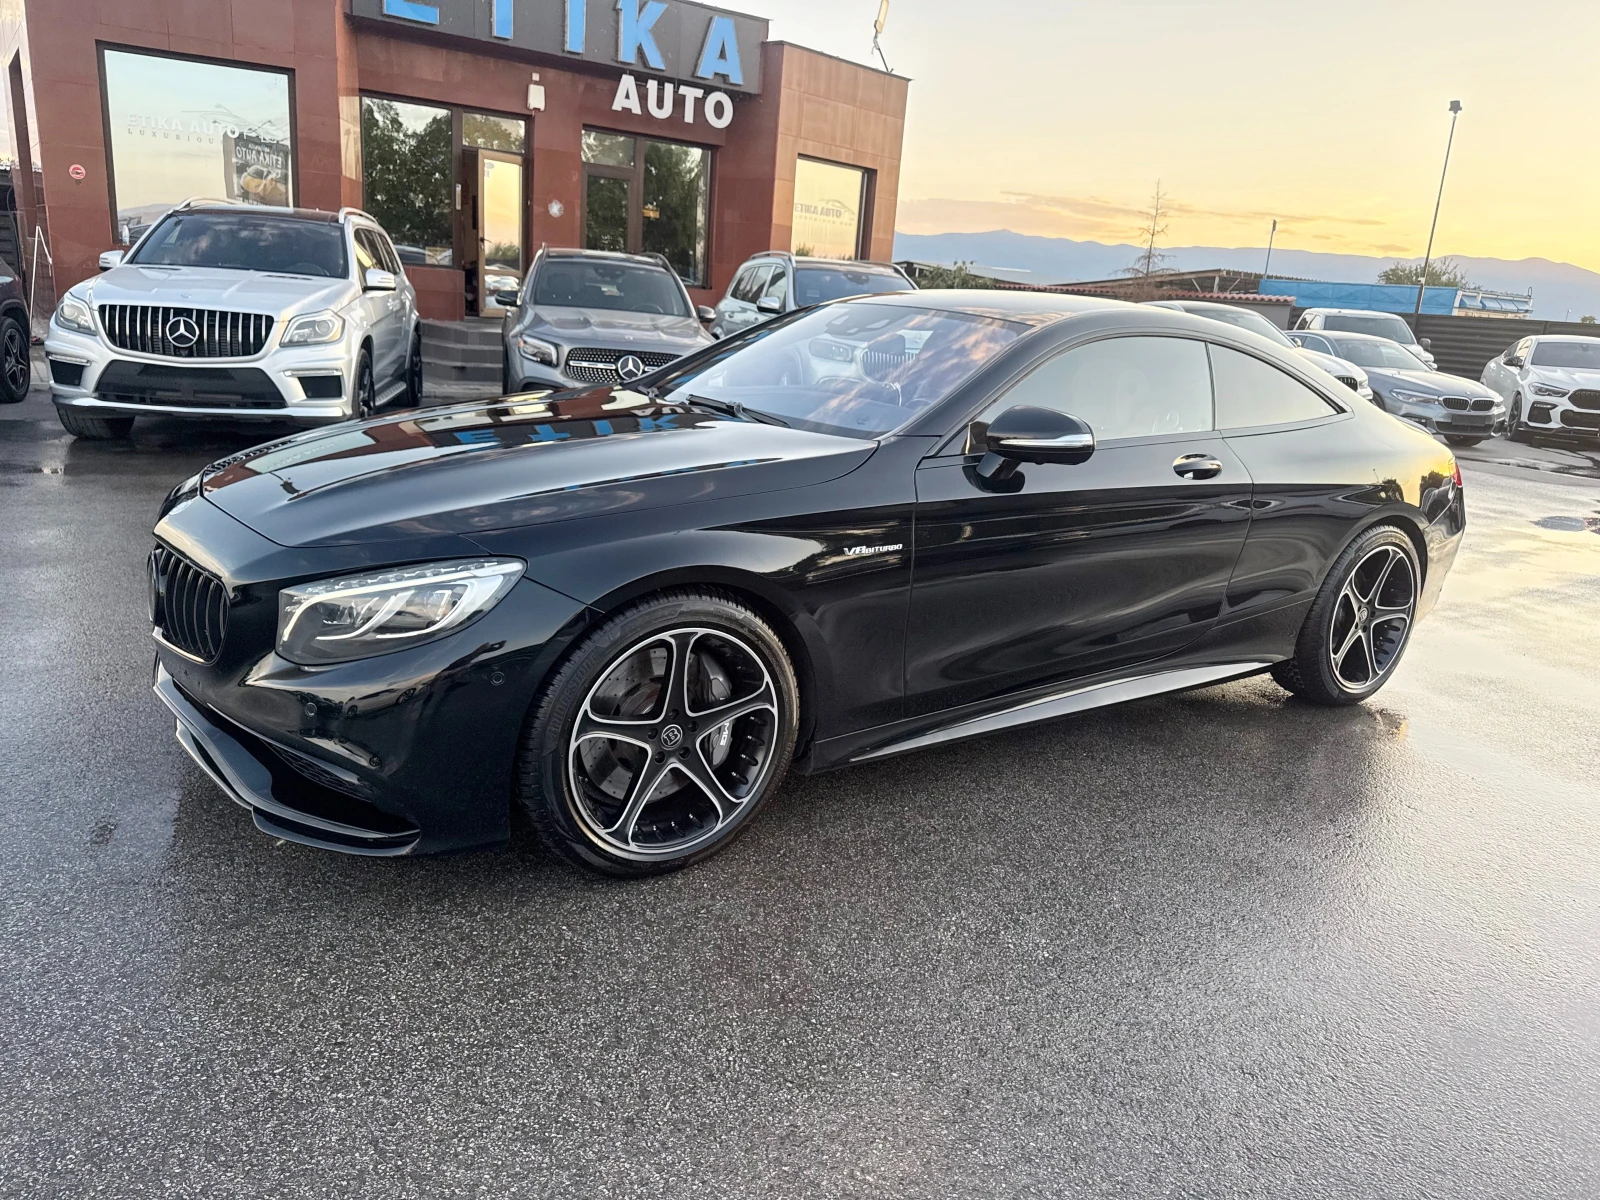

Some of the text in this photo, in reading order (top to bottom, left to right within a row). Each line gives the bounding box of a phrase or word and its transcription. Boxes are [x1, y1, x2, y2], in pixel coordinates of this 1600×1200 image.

[612, 74, 734, 129] AUTO
[128, 128, 221, 144] LUXURIOU
[190, 119, 239, 138] AUTO
